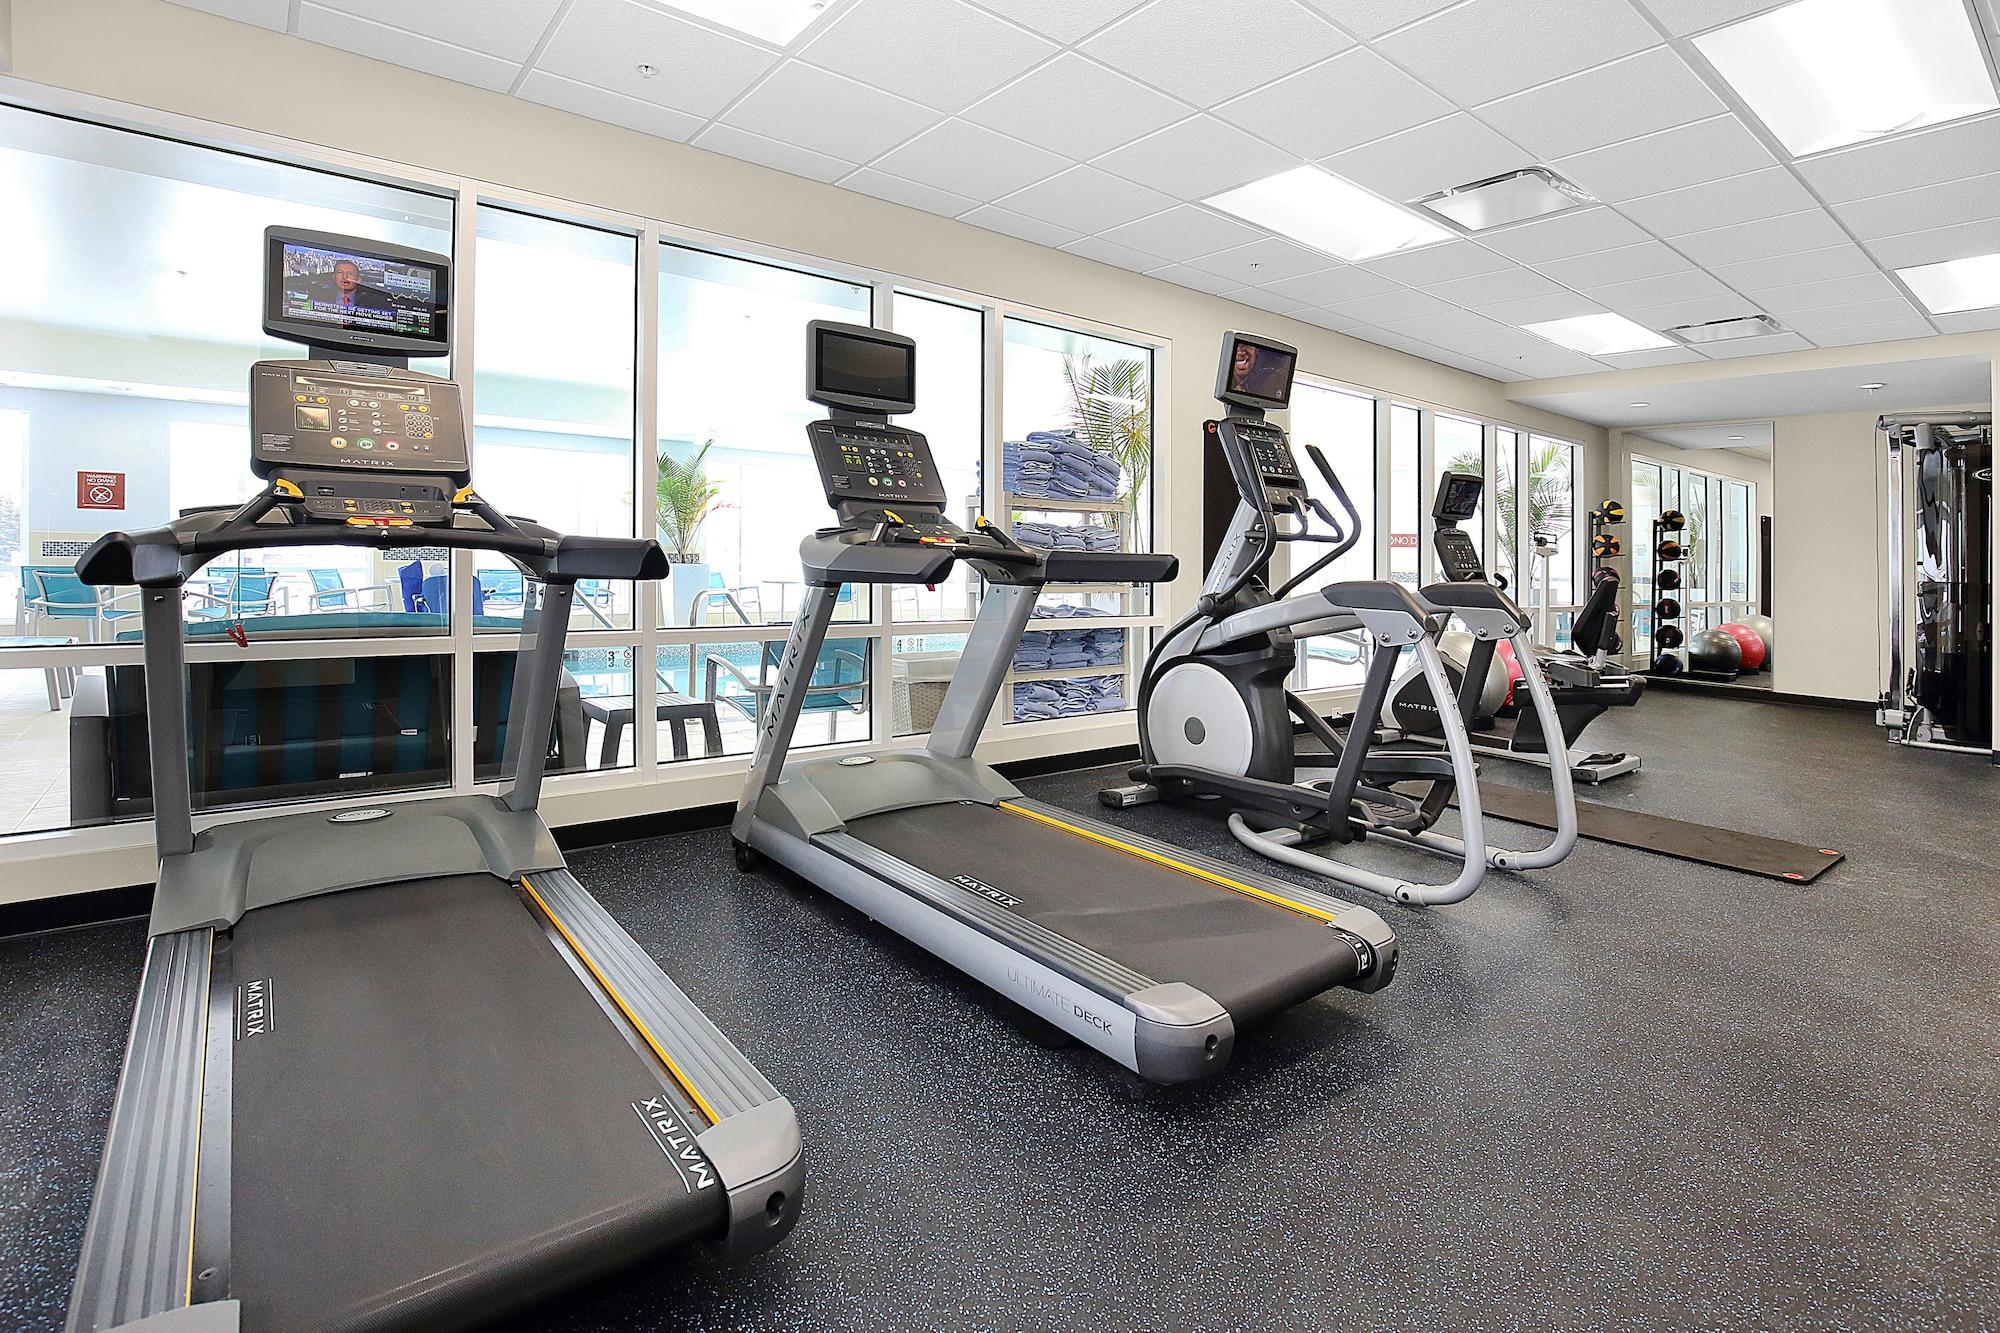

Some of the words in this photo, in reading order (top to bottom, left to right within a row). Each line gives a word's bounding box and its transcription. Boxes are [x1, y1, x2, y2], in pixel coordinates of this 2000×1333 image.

[340, 458, 395, 466] MATRIX
[878, 492, 909, 500] MATRIX
[766, 611, 811, 738] MATRIX
[1399, 702, 1440, 714] MATRIX
[953, 875, 1019, 907] MATRIX
[246, 980, 264, 1037] MATRIX
[1007, 967, 1071, 1014] ULTIMATE
[1073, 1004, 1113, 1036] DECK
[640, 1096, 715, 1190] MATRIX
